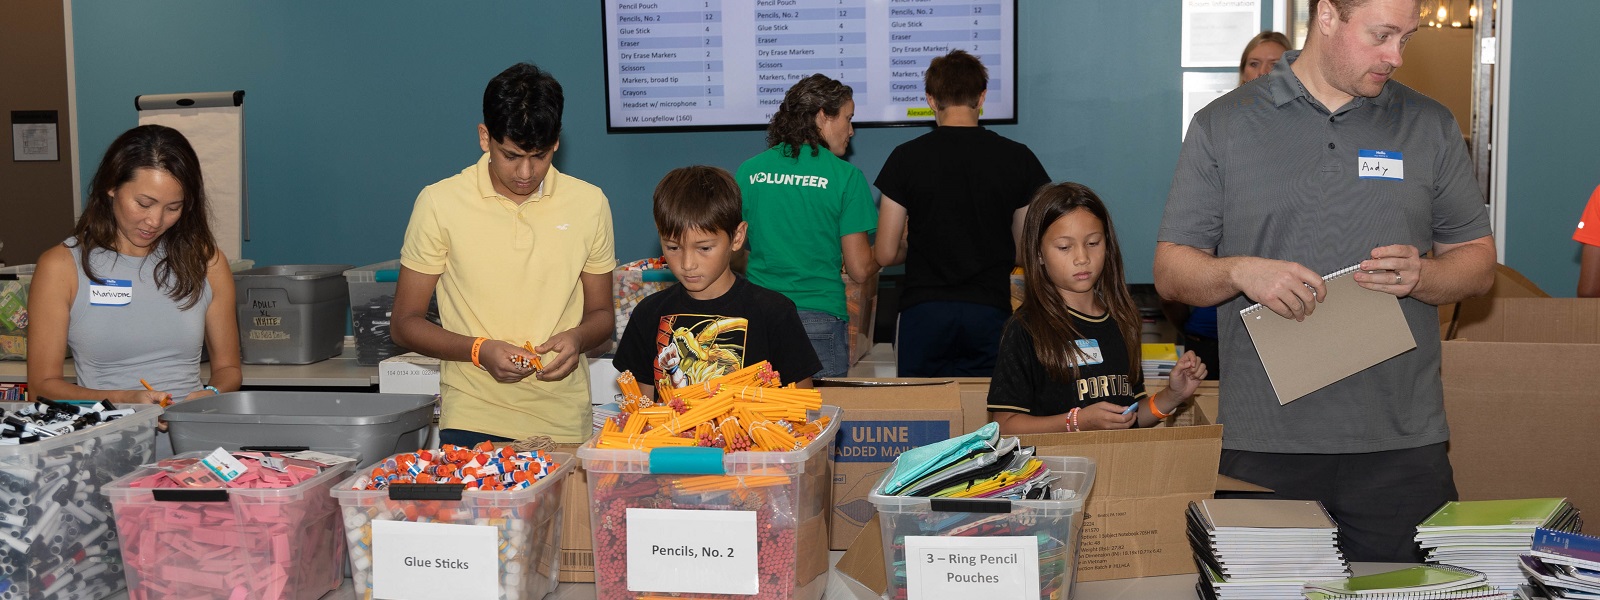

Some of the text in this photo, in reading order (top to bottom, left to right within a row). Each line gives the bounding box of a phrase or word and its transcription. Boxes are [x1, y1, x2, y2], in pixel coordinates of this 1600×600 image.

[1362, 162, 1388, 176] Andy
[750, 172, 828, 189] VOLUNTEER
[253, 300, 276, 308] ADULT
[256, 318, 278, 326] WHITE
[852, 427, 908, 442] ULINE
[835, 446, 877, 457] ADDED
[652, 545, 734, 558] Pencils, No. 2
[404, 556, 469, 569] Glue Sticks
[926, 553, 934, 563] 3
[949, 554, 976, 566] Ring
[980, 553, 1017, 564] Pencil
[947, 572, 999, 583] Pouches
